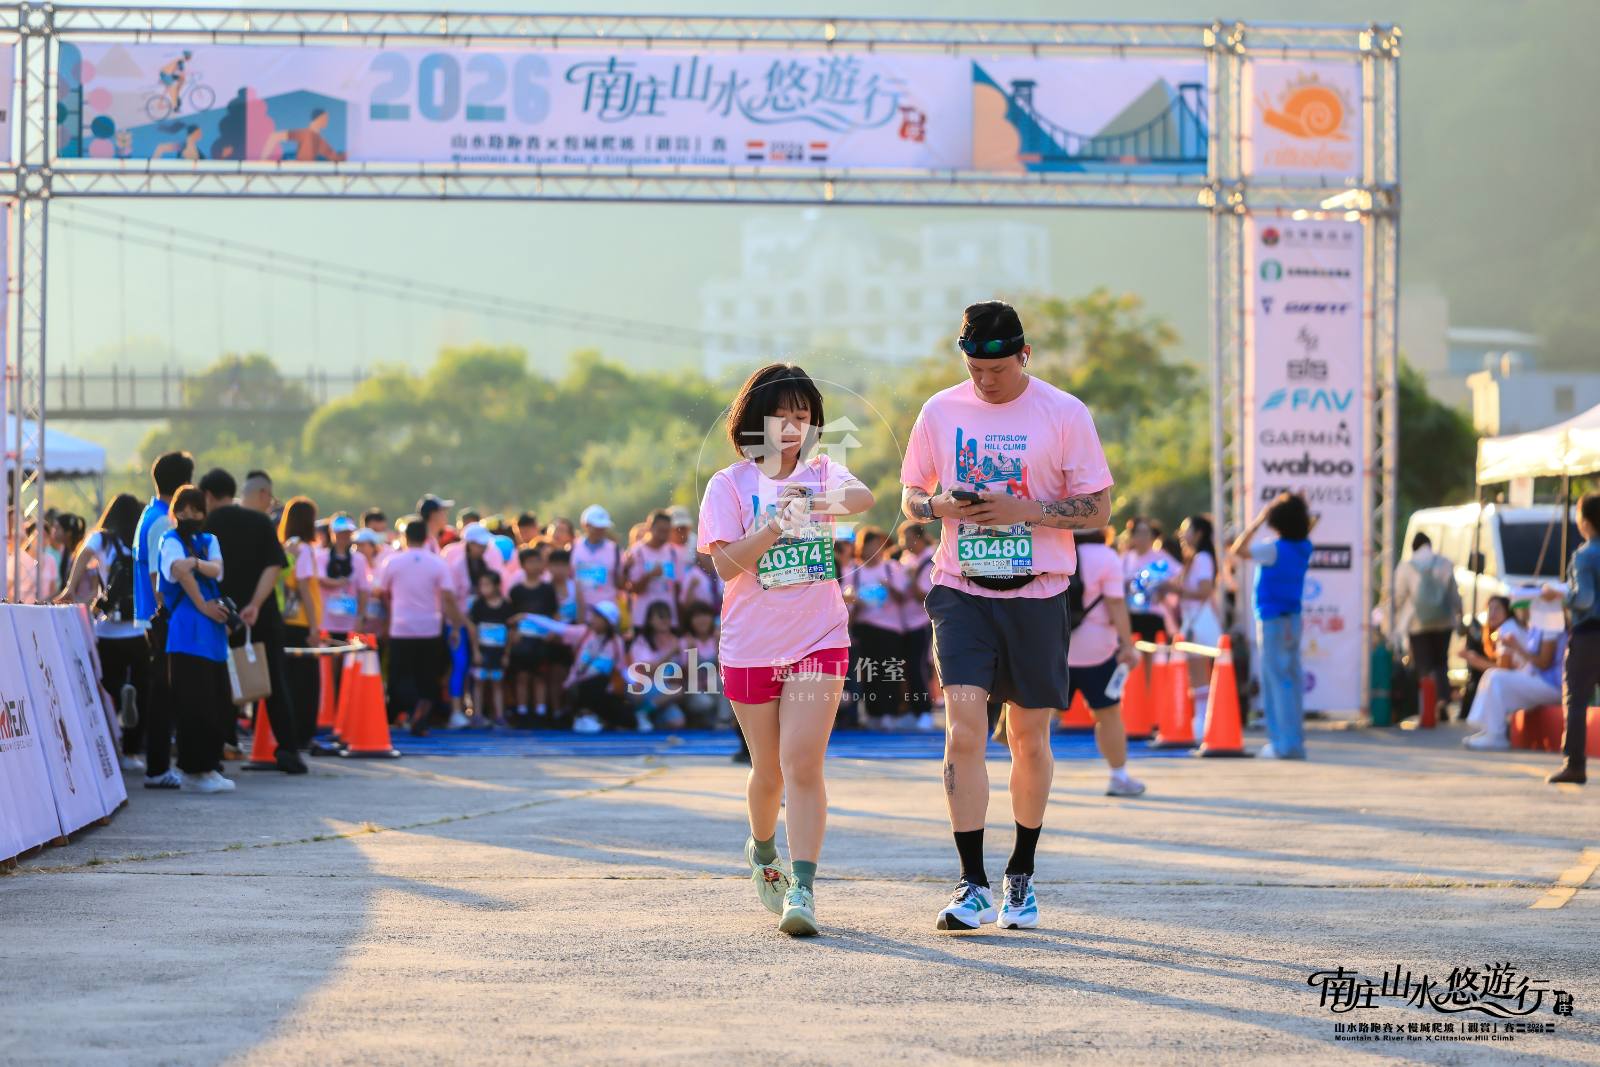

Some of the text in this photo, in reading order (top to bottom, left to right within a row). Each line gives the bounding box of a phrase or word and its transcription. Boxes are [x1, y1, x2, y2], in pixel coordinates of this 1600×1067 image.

[369, 52, 551, 124] 2026
[565, 55, 909, 133] 南庄山水悠遊行
[1291, 388, 1353, 411] FAV
[985, 434, 1028, 442] CITTASLOW
[1003, 443, 1027, 451] CLIMB
[1259, 428, 1352, 446] GARMIN
[1261, 453, 1354, 476] wahoo
[759, 543, 822, 571] 40374
[960, 538, 1030, 560] 30480
